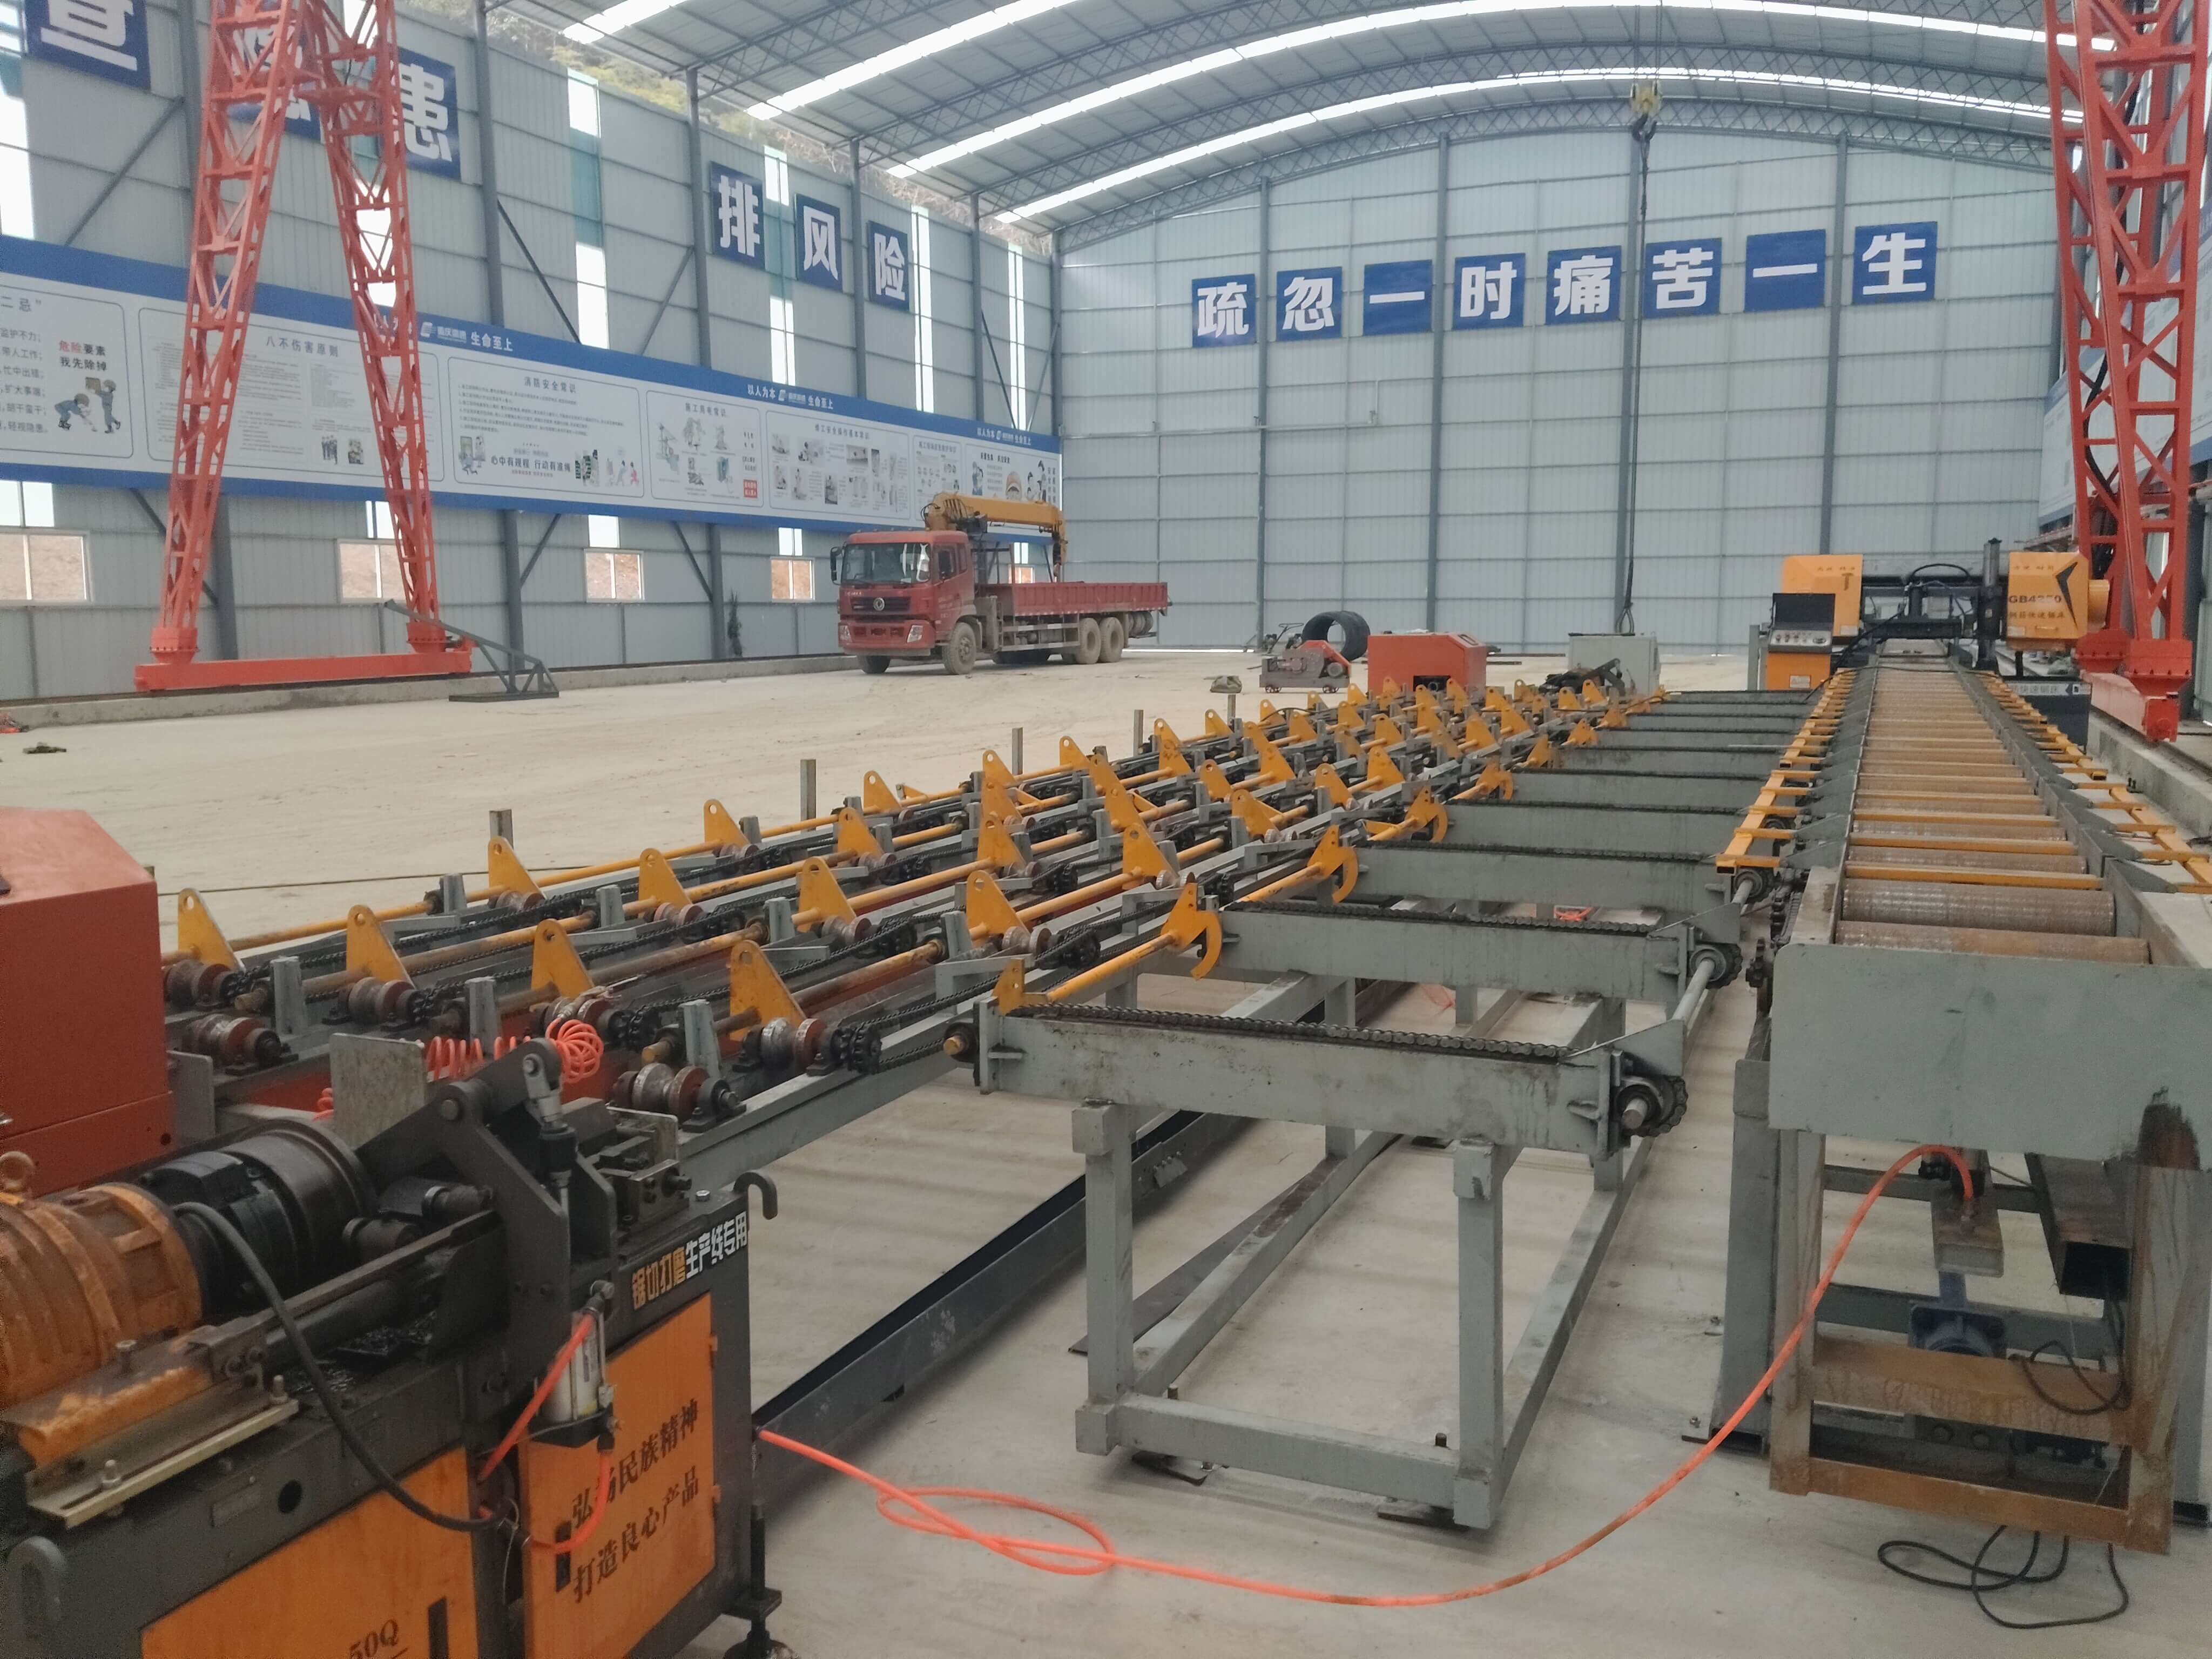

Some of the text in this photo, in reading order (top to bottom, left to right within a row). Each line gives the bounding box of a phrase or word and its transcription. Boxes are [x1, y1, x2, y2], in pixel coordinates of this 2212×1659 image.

[718, 174, 905, 301] 排风险
[1197, 232, 1927, 338] 疏忽一时痛苦一生
[59, 340, 106, 356] 危险要素
[266, 336, 339, 358] 八不伤害原则
[470, 331, 513, 352] 生命至上
[60, 356, 107, 372] 我先除掉
[747, 384, 776, 400] 以人为本
[808, 395, 834, 409] 生命至上
[572, 1465, 699, 1604] 打造良心产品
[349, 1618, 399, 1658] 50Q
